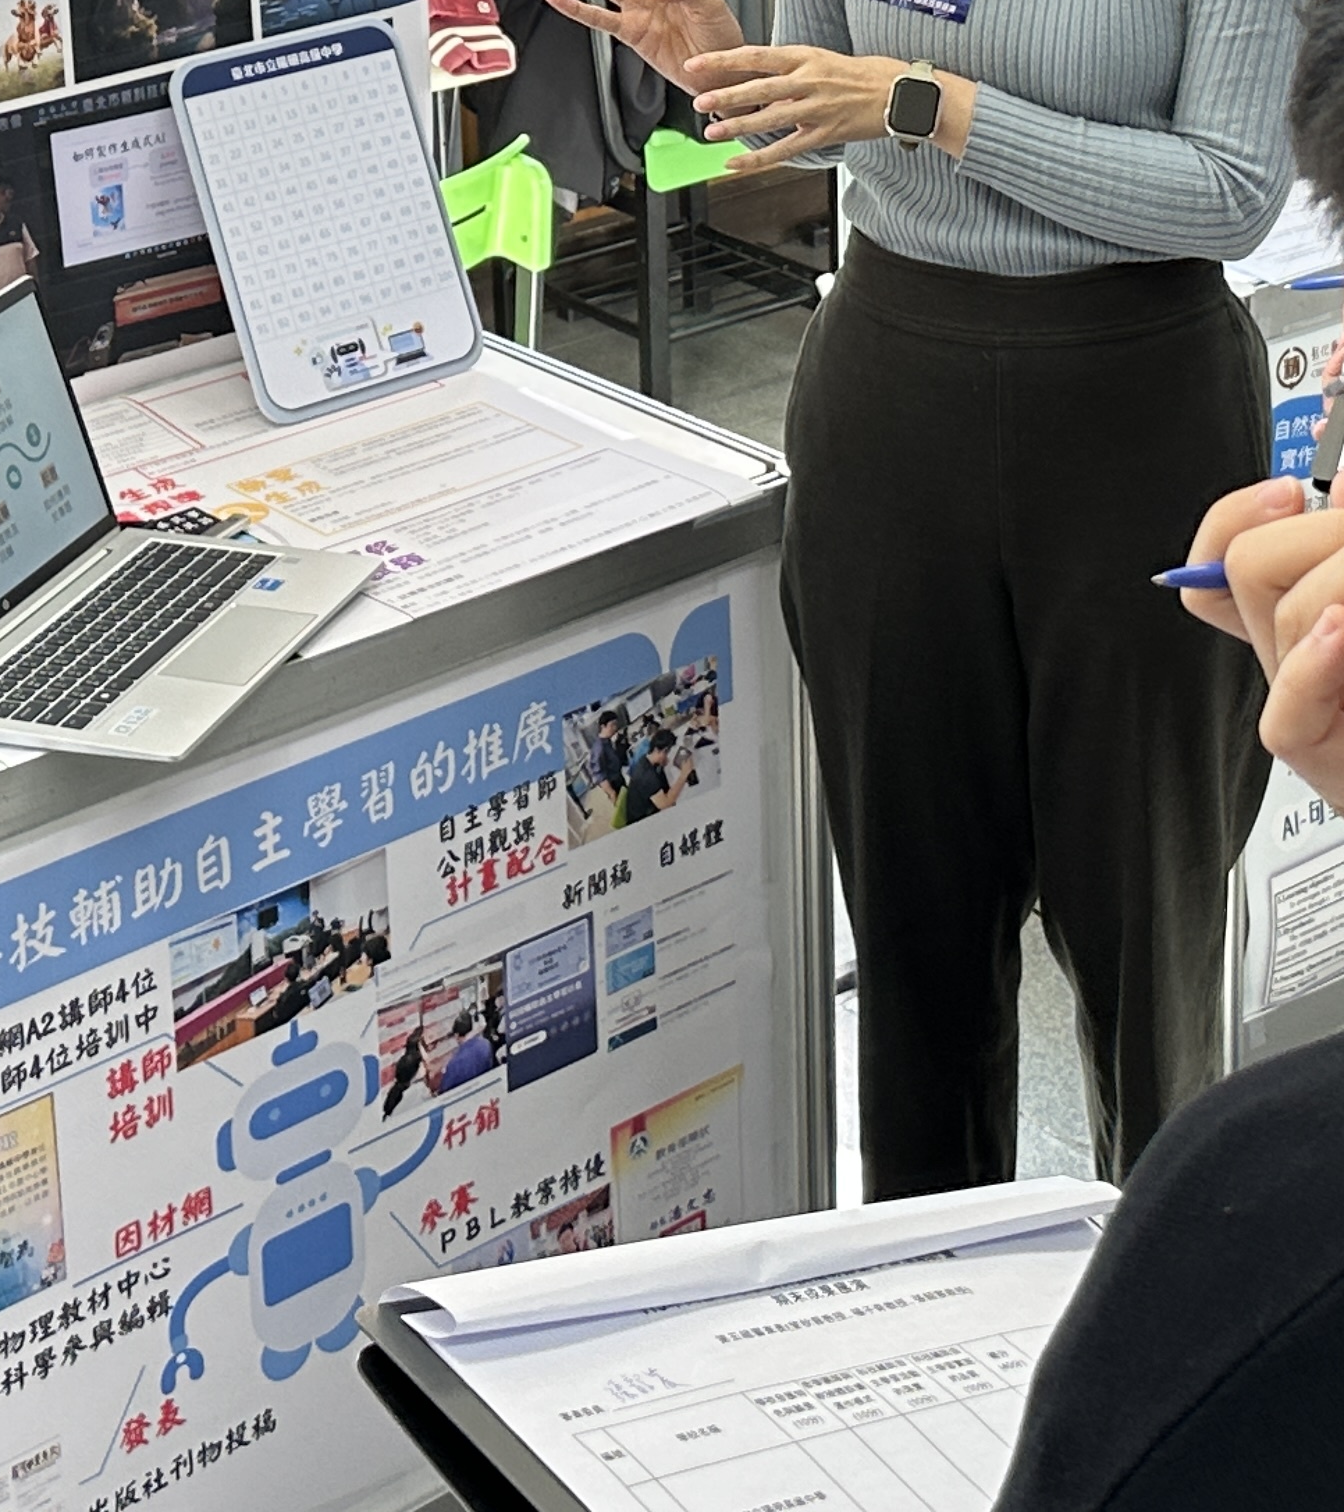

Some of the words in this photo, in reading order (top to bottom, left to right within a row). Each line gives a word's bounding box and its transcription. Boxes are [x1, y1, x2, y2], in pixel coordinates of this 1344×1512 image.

[438, 771, 558, 844] 自主學習節
[561, 859, 633, 910] 新聞稿
[659, 819, 725, 868] 自媒體
[105, 1044, 173, 1101] 講師
[108, 1086, 175, 1144] 培訓
[442, 1097, 502, 1151] 行銷
[114, 1185, 214, 1259] 因材網
[418, 1180, 479, 1235] 參賽
[119, 1397, 187, 1455] 發表
